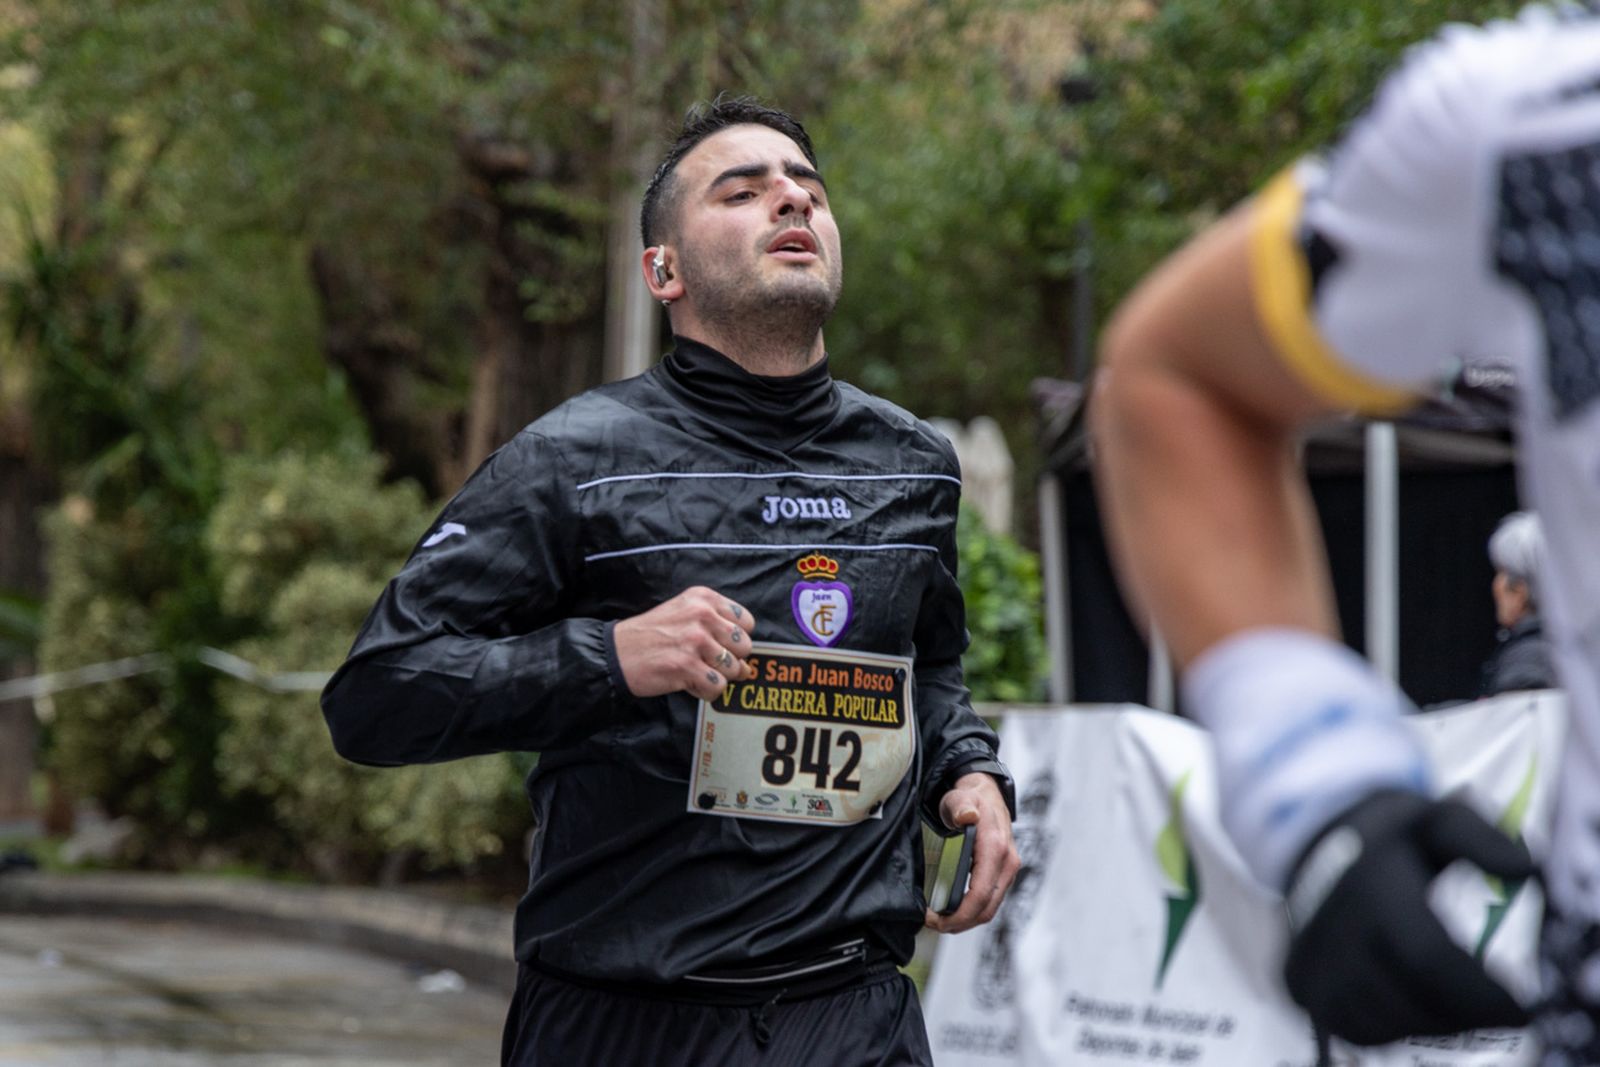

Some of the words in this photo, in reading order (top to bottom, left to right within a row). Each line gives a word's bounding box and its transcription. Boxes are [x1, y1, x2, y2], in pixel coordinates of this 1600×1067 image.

[762, 496, 852, 523] Joma
[765, 659, 803, 683] San
[808, 663, 849, 687] Juan
[853, 667, 895, 692] Bosco
[741, 685, 828, 717] CARRERA
[833, 692, 900, 724] POPULAR
[761, 723, 863, 792] 842
